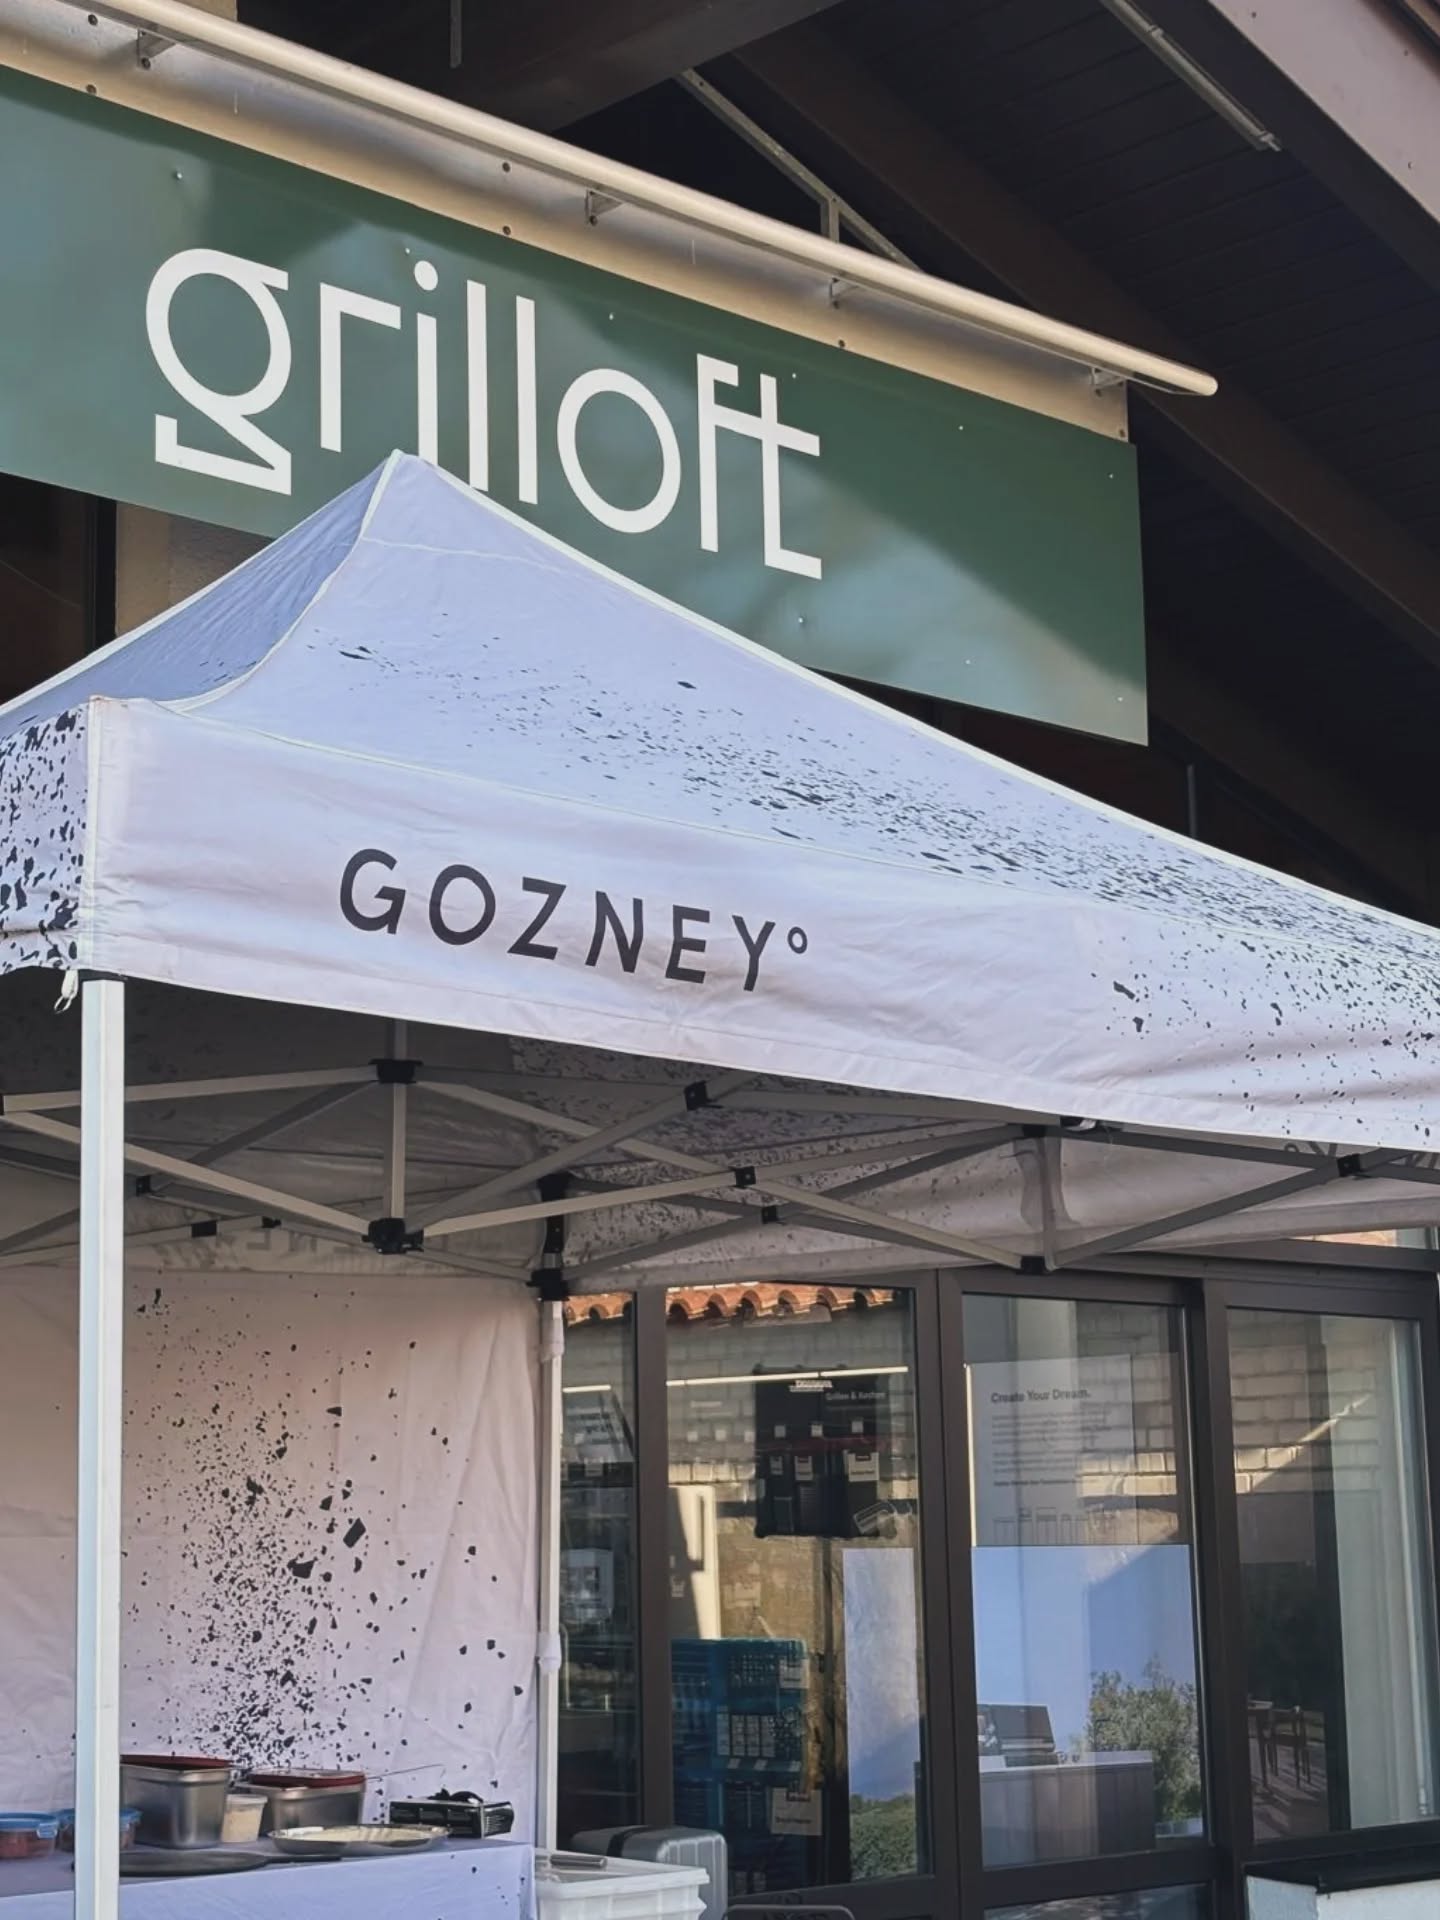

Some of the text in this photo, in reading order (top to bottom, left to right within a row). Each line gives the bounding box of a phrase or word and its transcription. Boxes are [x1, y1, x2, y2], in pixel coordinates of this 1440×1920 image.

[146, 248, 822, 580] grilloft
[991, 1392, 1024, 1403] Create
[1027, 1390, 1049, 1401] Your
